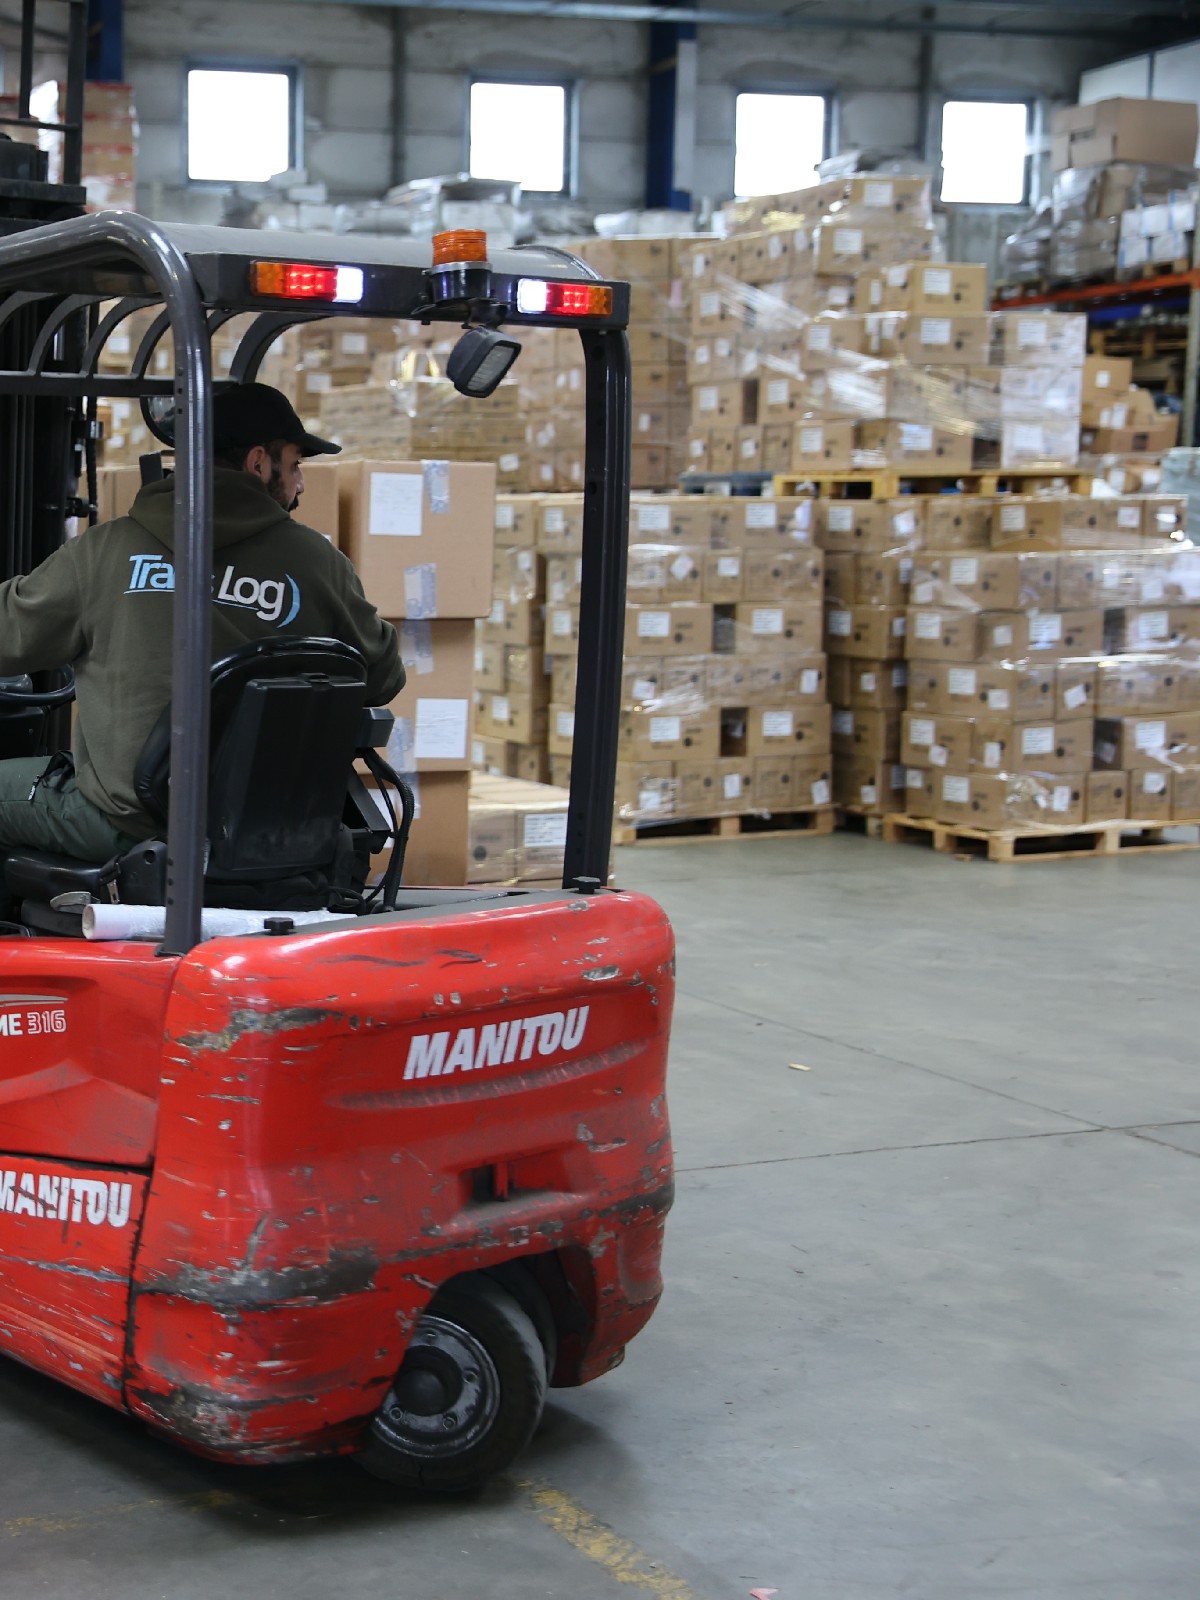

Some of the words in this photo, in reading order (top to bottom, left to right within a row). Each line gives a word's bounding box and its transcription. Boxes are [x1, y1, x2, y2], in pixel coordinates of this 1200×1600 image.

[217, 565, 285, 621] Log
[27, 1010, 66, 1034] 316
[403, 1006, 590, 1080] MANITOU
